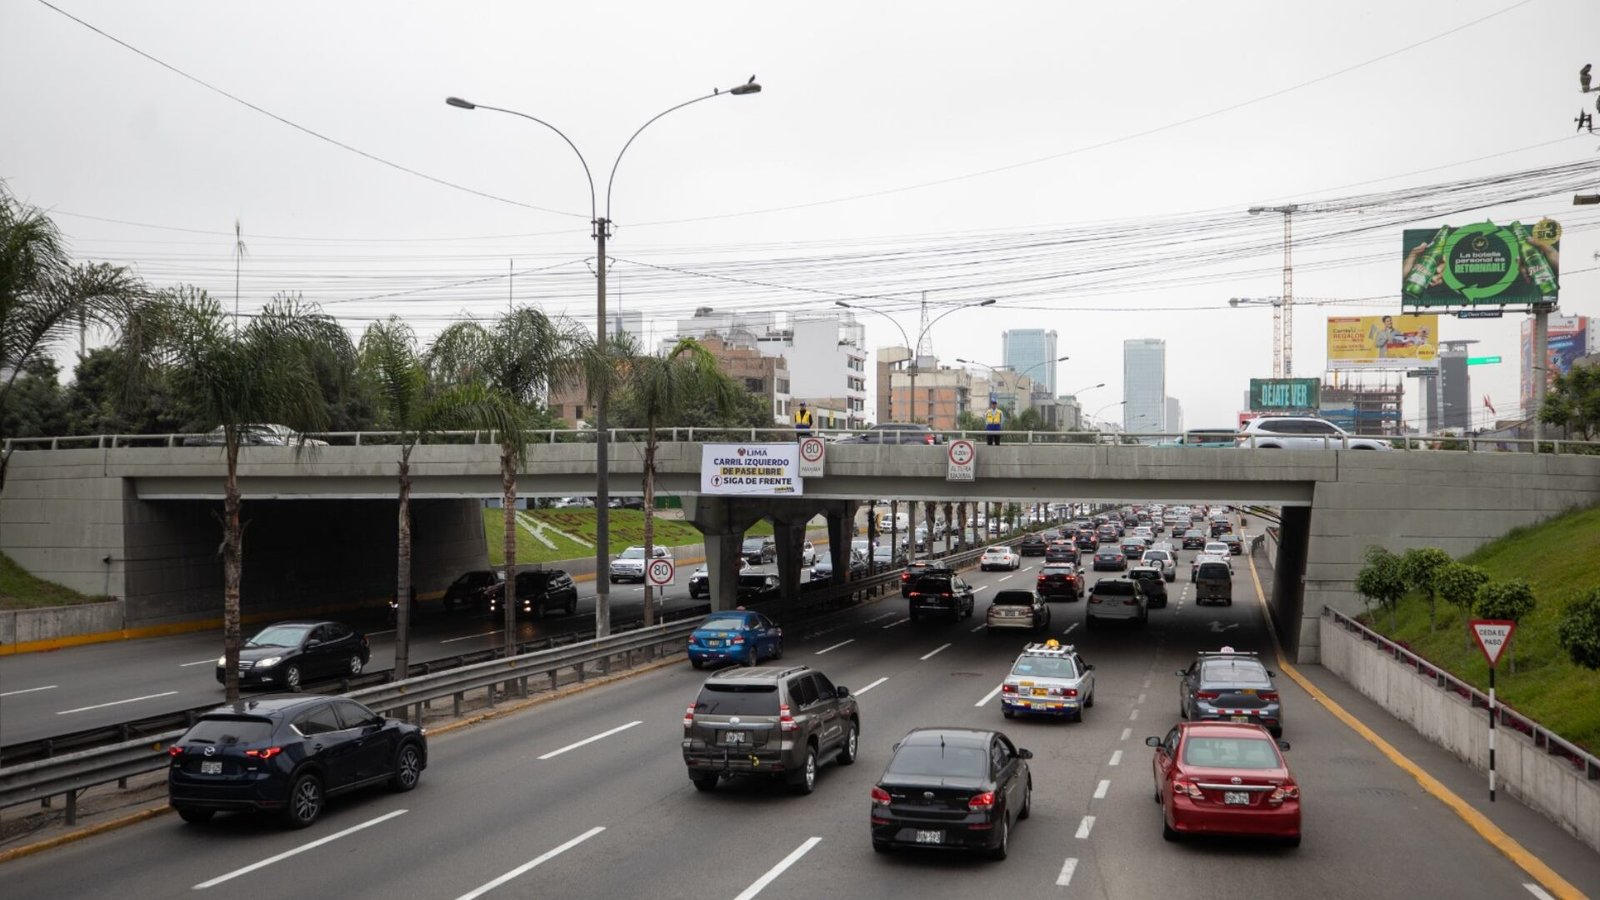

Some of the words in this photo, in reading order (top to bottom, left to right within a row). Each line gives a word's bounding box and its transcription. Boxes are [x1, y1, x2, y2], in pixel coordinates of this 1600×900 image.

[1454, 263, 1506, 273] RETORNABLE
[1291, 384, 1307, 406] VER
[805, 443, 819, 454] 80
[713, 458, 743, 466] CARRIL
[744, 458, 790, 467] IZQUIERDO
[723, 477, 744, 485] SIGA
[745, 477, 757, 485] DE
[759, 477, 792, 485] FRENTE
[654, 564, 669, 576] 80
